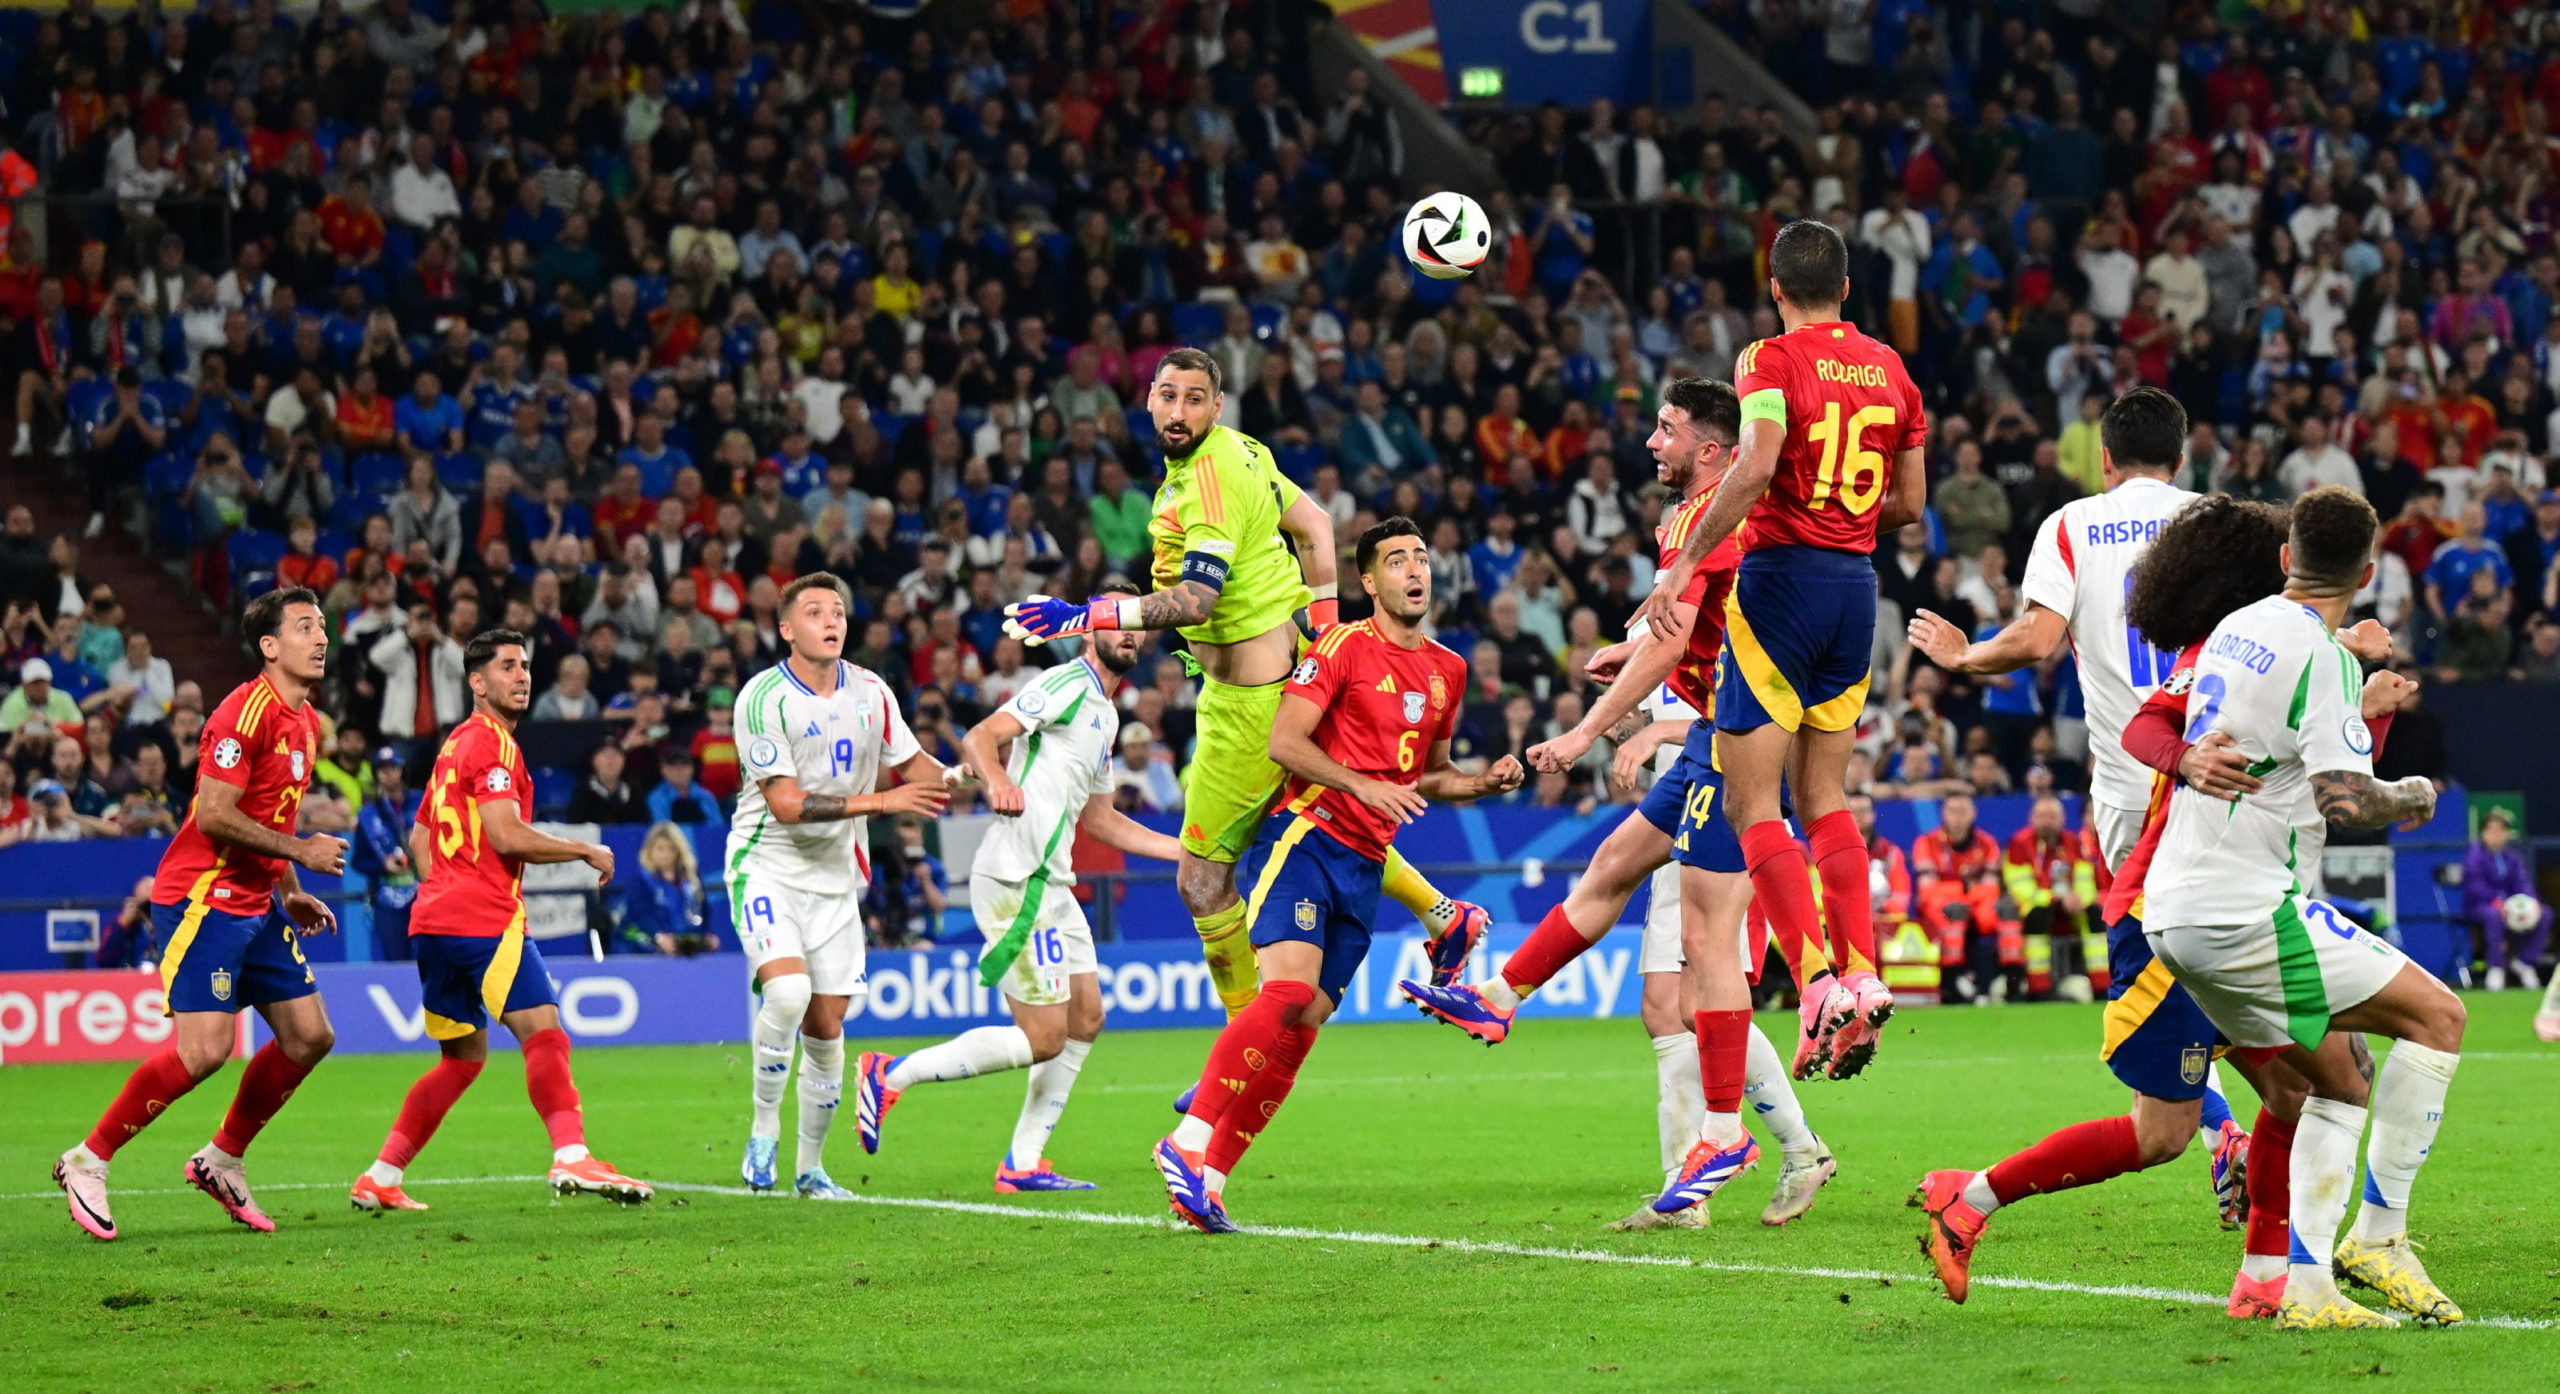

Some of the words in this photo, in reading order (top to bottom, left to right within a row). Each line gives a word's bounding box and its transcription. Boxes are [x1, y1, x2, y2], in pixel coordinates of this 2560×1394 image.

[1519, 0, 1618, 55] C1
[1816, 358, 1888, 388] RODRIGO
[1807, 401, 1896, 516] 16
[2208, 633, 2276, 675] LORENZO
[829, 738, 853, 778] 19
[1398, 730, 1420, 773] 6
[1680, 780, 1717, 831] 14
[744, 896, 775, 933] 19
[2305, 901, 2357, 940] 2
[1034, 927, 1064, 966] 16
[0, 988, 174, 1065] pres
